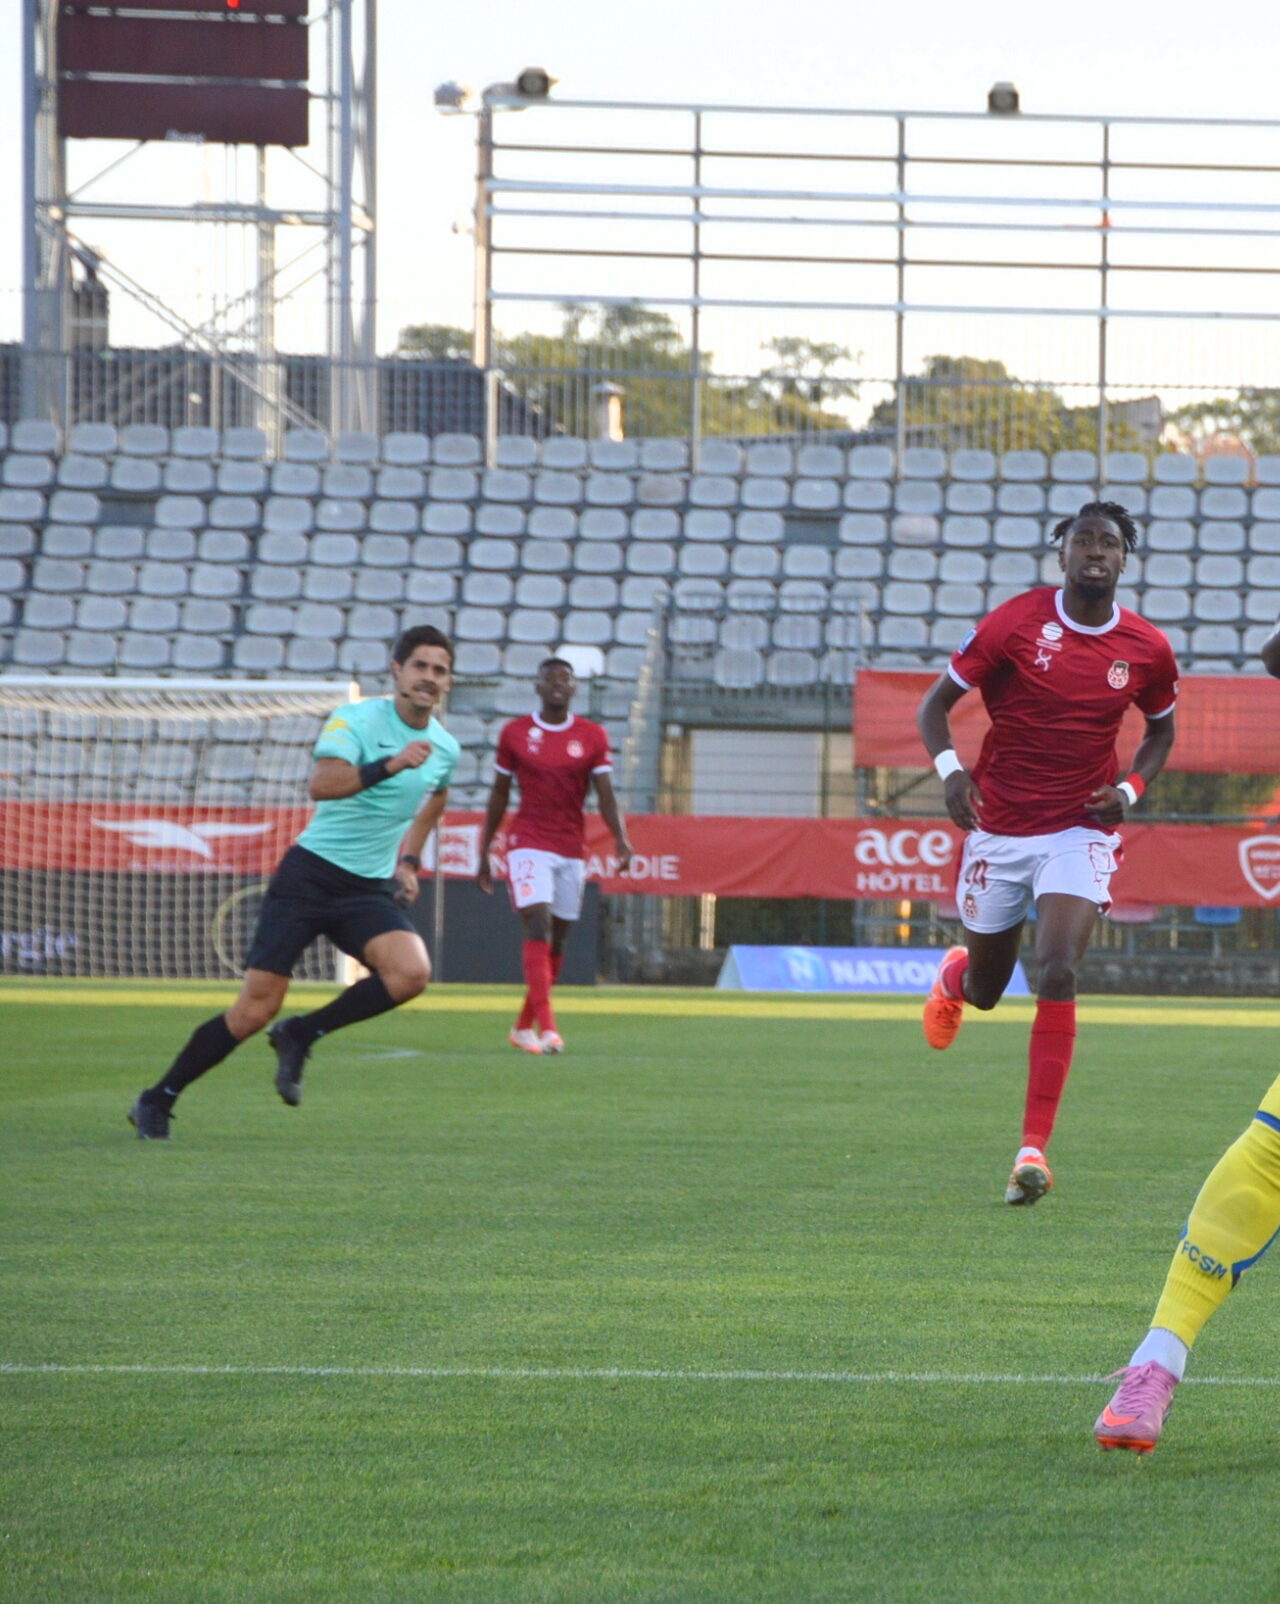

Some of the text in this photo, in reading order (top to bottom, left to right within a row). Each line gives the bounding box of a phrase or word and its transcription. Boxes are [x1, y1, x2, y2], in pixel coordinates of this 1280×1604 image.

[854, 828, 954, 866] ace
[856, 868, 950, 893] HÔTEL
[1181, 1240, 1228, 1280] FCSM
